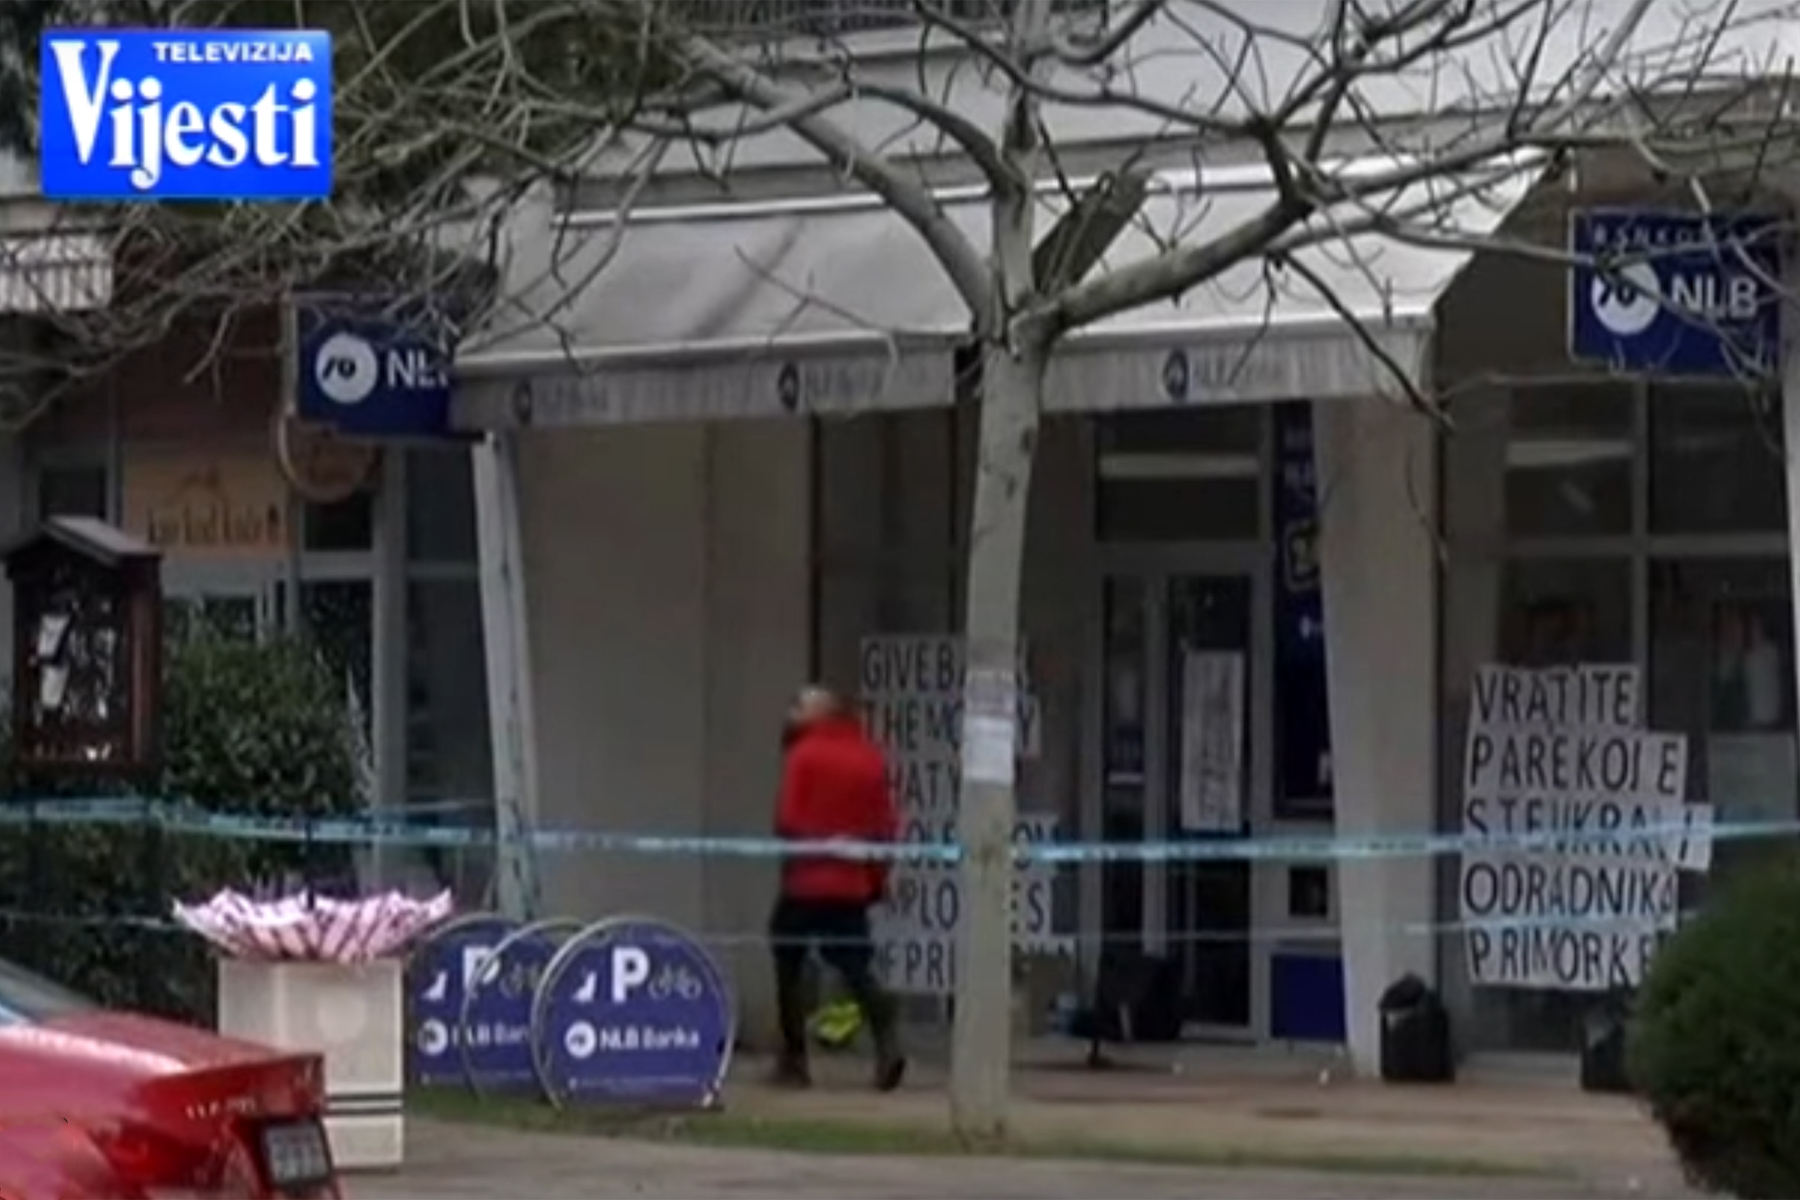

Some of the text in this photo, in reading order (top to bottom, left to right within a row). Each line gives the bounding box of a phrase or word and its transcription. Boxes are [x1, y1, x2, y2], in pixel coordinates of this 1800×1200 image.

[386, 349, 449, 389] NL
[1474, 670, 1634, 725] VRATITE
[462, 945, 501, 1000] P
[611, 945, 650, 1004] P
